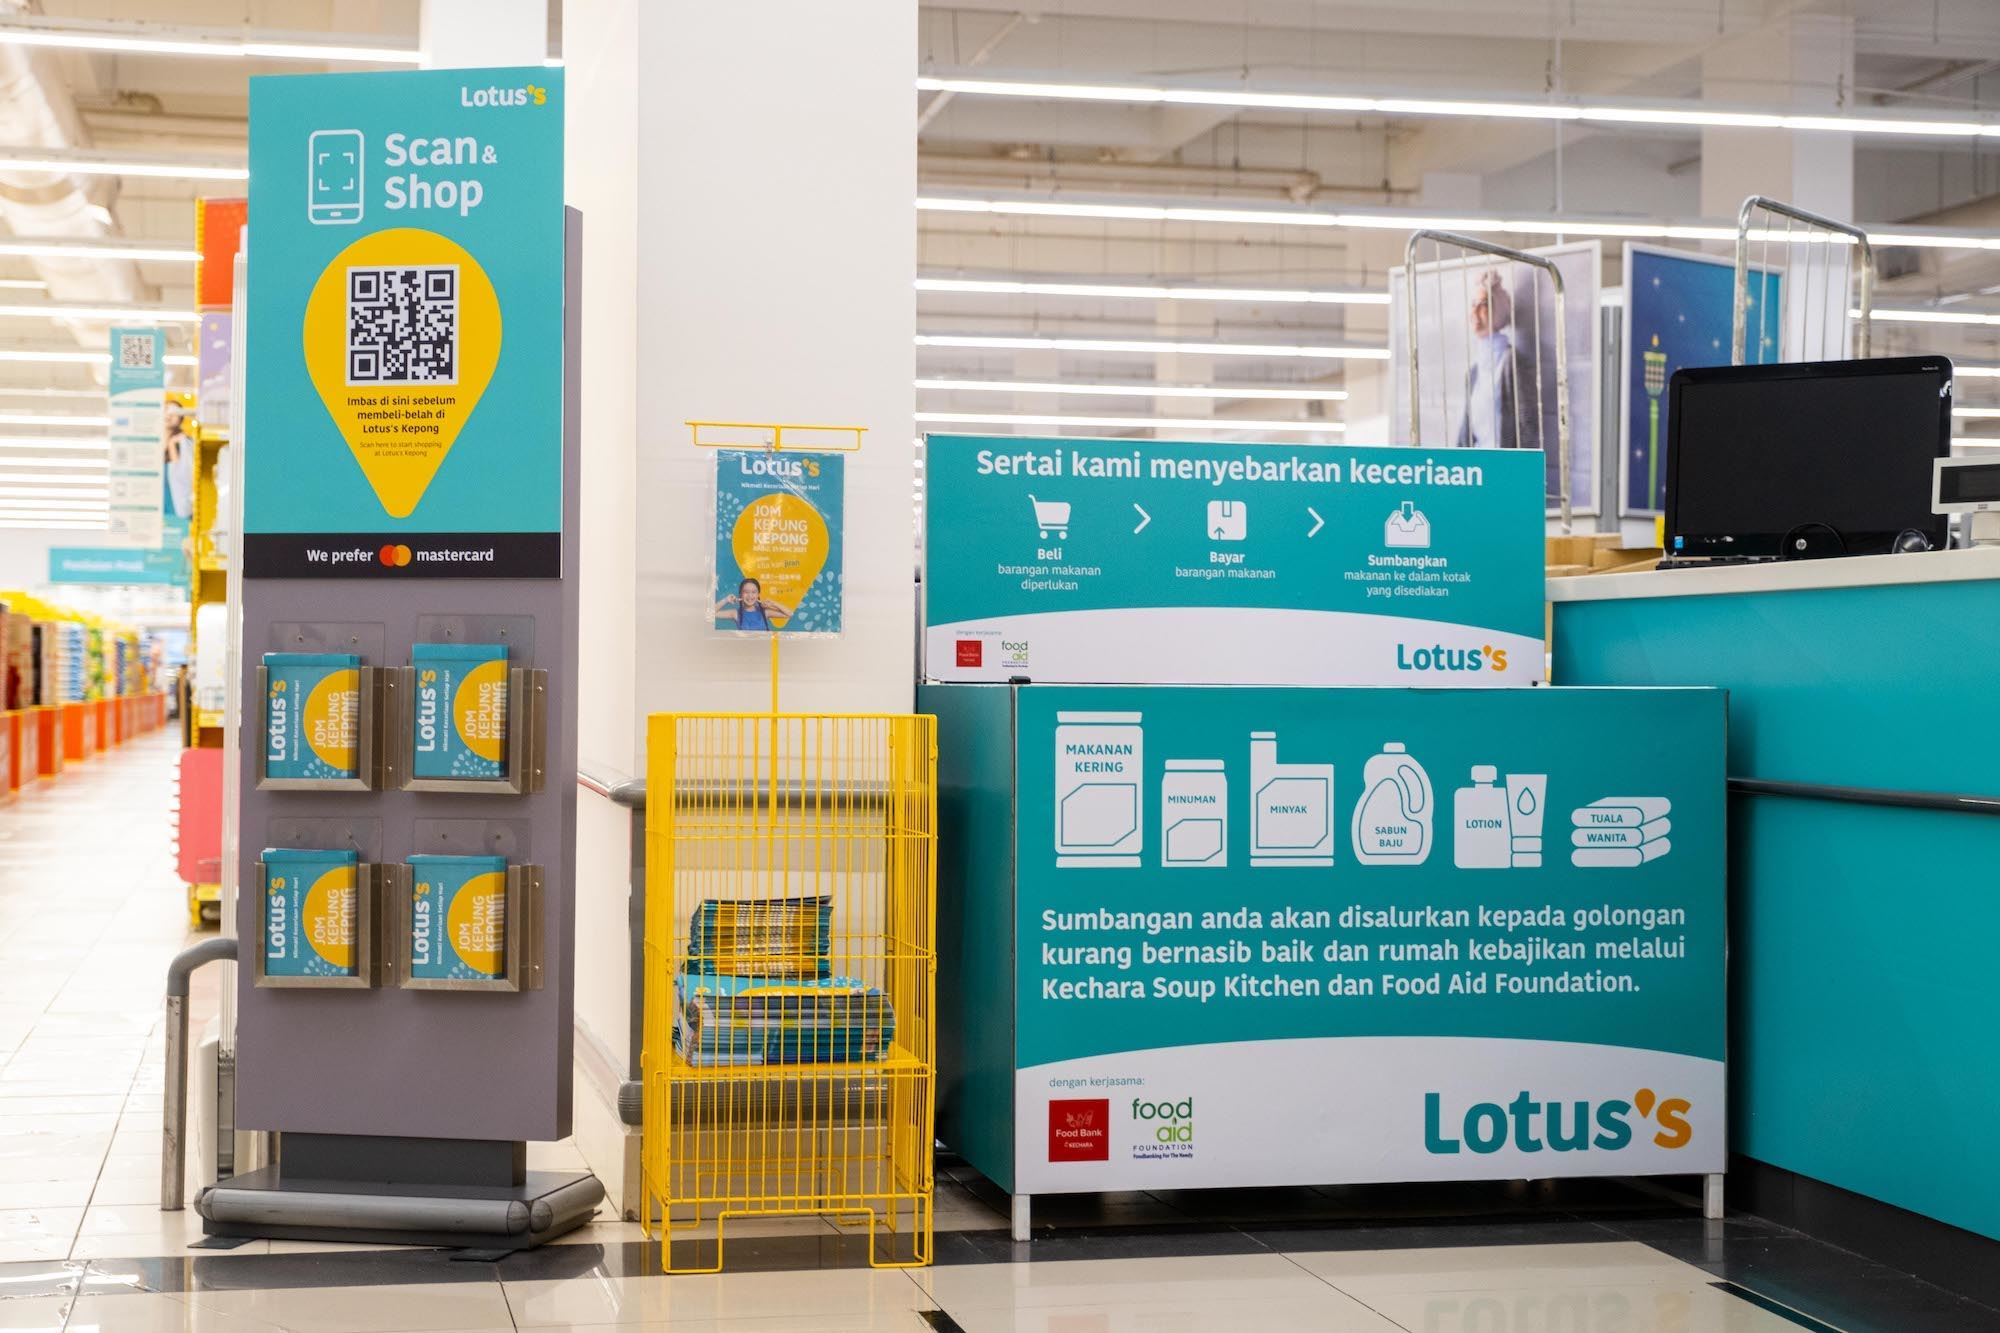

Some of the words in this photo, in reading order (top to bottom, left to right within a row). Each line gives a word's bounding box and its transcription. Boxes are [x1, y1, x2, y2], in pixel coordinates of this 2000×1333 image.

[461, 85, 546, 107] Lotus's
[384, 132, 478, 167] Scan
[482, 144, 498, 164] &
[384, 173, 483, 216] Shop
[347, 397, 377, 406] Imbas
[380, 396, 389, 405] di
[392, 396, 410, 405] sini
[413, 396, 456, 405] sebelum
[357, 409, 433, 419] membeli-belah
[436, 409, 445, 418] di
[363, 424, 399, 433] Lotus's
[401, 424, 439, 434] Kepong
[415, 441, 442, 449] shopping
[741, 456, 820, 478] Lotus's
[976, 449, 1062, 476] Sertai
[1072, 450, 1141, 478] kami
[1150, 455, 1341, 486] menyebarkan
[1350, 457, 1483, 486] keceriaan
[754, 505, 781, 517] JOM
[754, 518, 808, 532] KEPUNG
[753, 532, 809, 545] KEPONG
[306, 549, 329, 562] We
[331, 548, 374, 565] prefer
[416, 549, 494, 562] mastercard
[1037, 548, 1062, 560] Beli
[1210, 551, 1245, 565] Bayar
[1367, 554, 1447, 569] Sumbangkan
[998, 564, 1049, 576] barangan
[1052, 565, 1101, 576] makanan
[1175, 567, 1226, 580] barangan
[1227, 567, 1276, 579] makanan
[1344, 570, 1392, 581] makanan
[1393, 571, 1405, 582] ke
[1408, 570, 1441, 582] dalam
[1442, 571, 1471, 583] kotak
[1021, 579, 1078, 592] diperlukan
[1366, 587, 1392, 598] yang
[1394, 585, 1449, 597] disediakan
[1002, 640, 1028, 650] food
[1396, 643, 1508, 671] Lotus's
[417, 670, 436, 752] Lotus's
[478, 682, 491, 739] KEPUNG
[269, 680, 287, 761] Lotus's
[328, 692, 340, 748] KEPUNG
[465, 710, 477, 739] JOM
[315, 720, 326, 748] JOM
[1066, 744, 1133, 755] MAKANAN
[1075, 762, 1123, 773] KERING
[1168, 795, 1216, 804] MINUMAN
[1270, 805, 1307, 814] MINYAK
[1466, 819, 1502, 829] LOTION
[1590, 813, 1623, 824] TUALA
[1375, 826, 1407, 835] SABUN
[1586, 832, 1627, 843] WANITA
[1379, 838, 1403, 848] BAJU
[268, 877, 286, 959] Lotus's
[327, 889, 339, 945] KEPUNG
[412, 882, 430, 965] Lotus's
[472, 896, 484, 952] KEPUNG
[1042, 908, 1193, 934] Sumbangan
[1201, 907, 1263, 929] anda
[1270, 907, 1330, 929] akan
[1339, 904, 1469, 928] disalurkan
[1478, 905, 1566, 931] kepada
[1573, 904, 1685, 931] golongan
[314, 917, 326, 945] JOM
[459, 923, 471, 952] JOM
[1042, 942, 1132, 969] kurang
[1142, 939, 1251, 964] bernasib
[1262, 939, 1314, 962] baik
[1323, 940, 1369, 962] dan
[1379, 938, 1459, 961] rumah
[1469, 937, 1586, 965] kebajikan
[1595, 936, 1685, 959] melalui
[1042, 976, 1146, 999] Kechara
[1153, 976, 1216, 1002] Soup
[1224, 973, 1320, 997] Kitchen
[1328, 974, 1373, 996] dan
[1382, 972, 1440, 995] Food
[1448, 971, 1487, 994] Aid
[1495, 969, 1640, 993] Foundation.
[1049, 1077, 1087, 1088] dengan
[1090, 1076, 1145, 1088] kerjasama:
[1132, 1097, 1192, 1120] food
[1424, 1088, 1693, 1154] Lotus's
[1055, 1129, 1078, 1138] Food
[1080, 1128, 1102, 1137] Bank
[1156, 1122, 1192, 1142] aid
